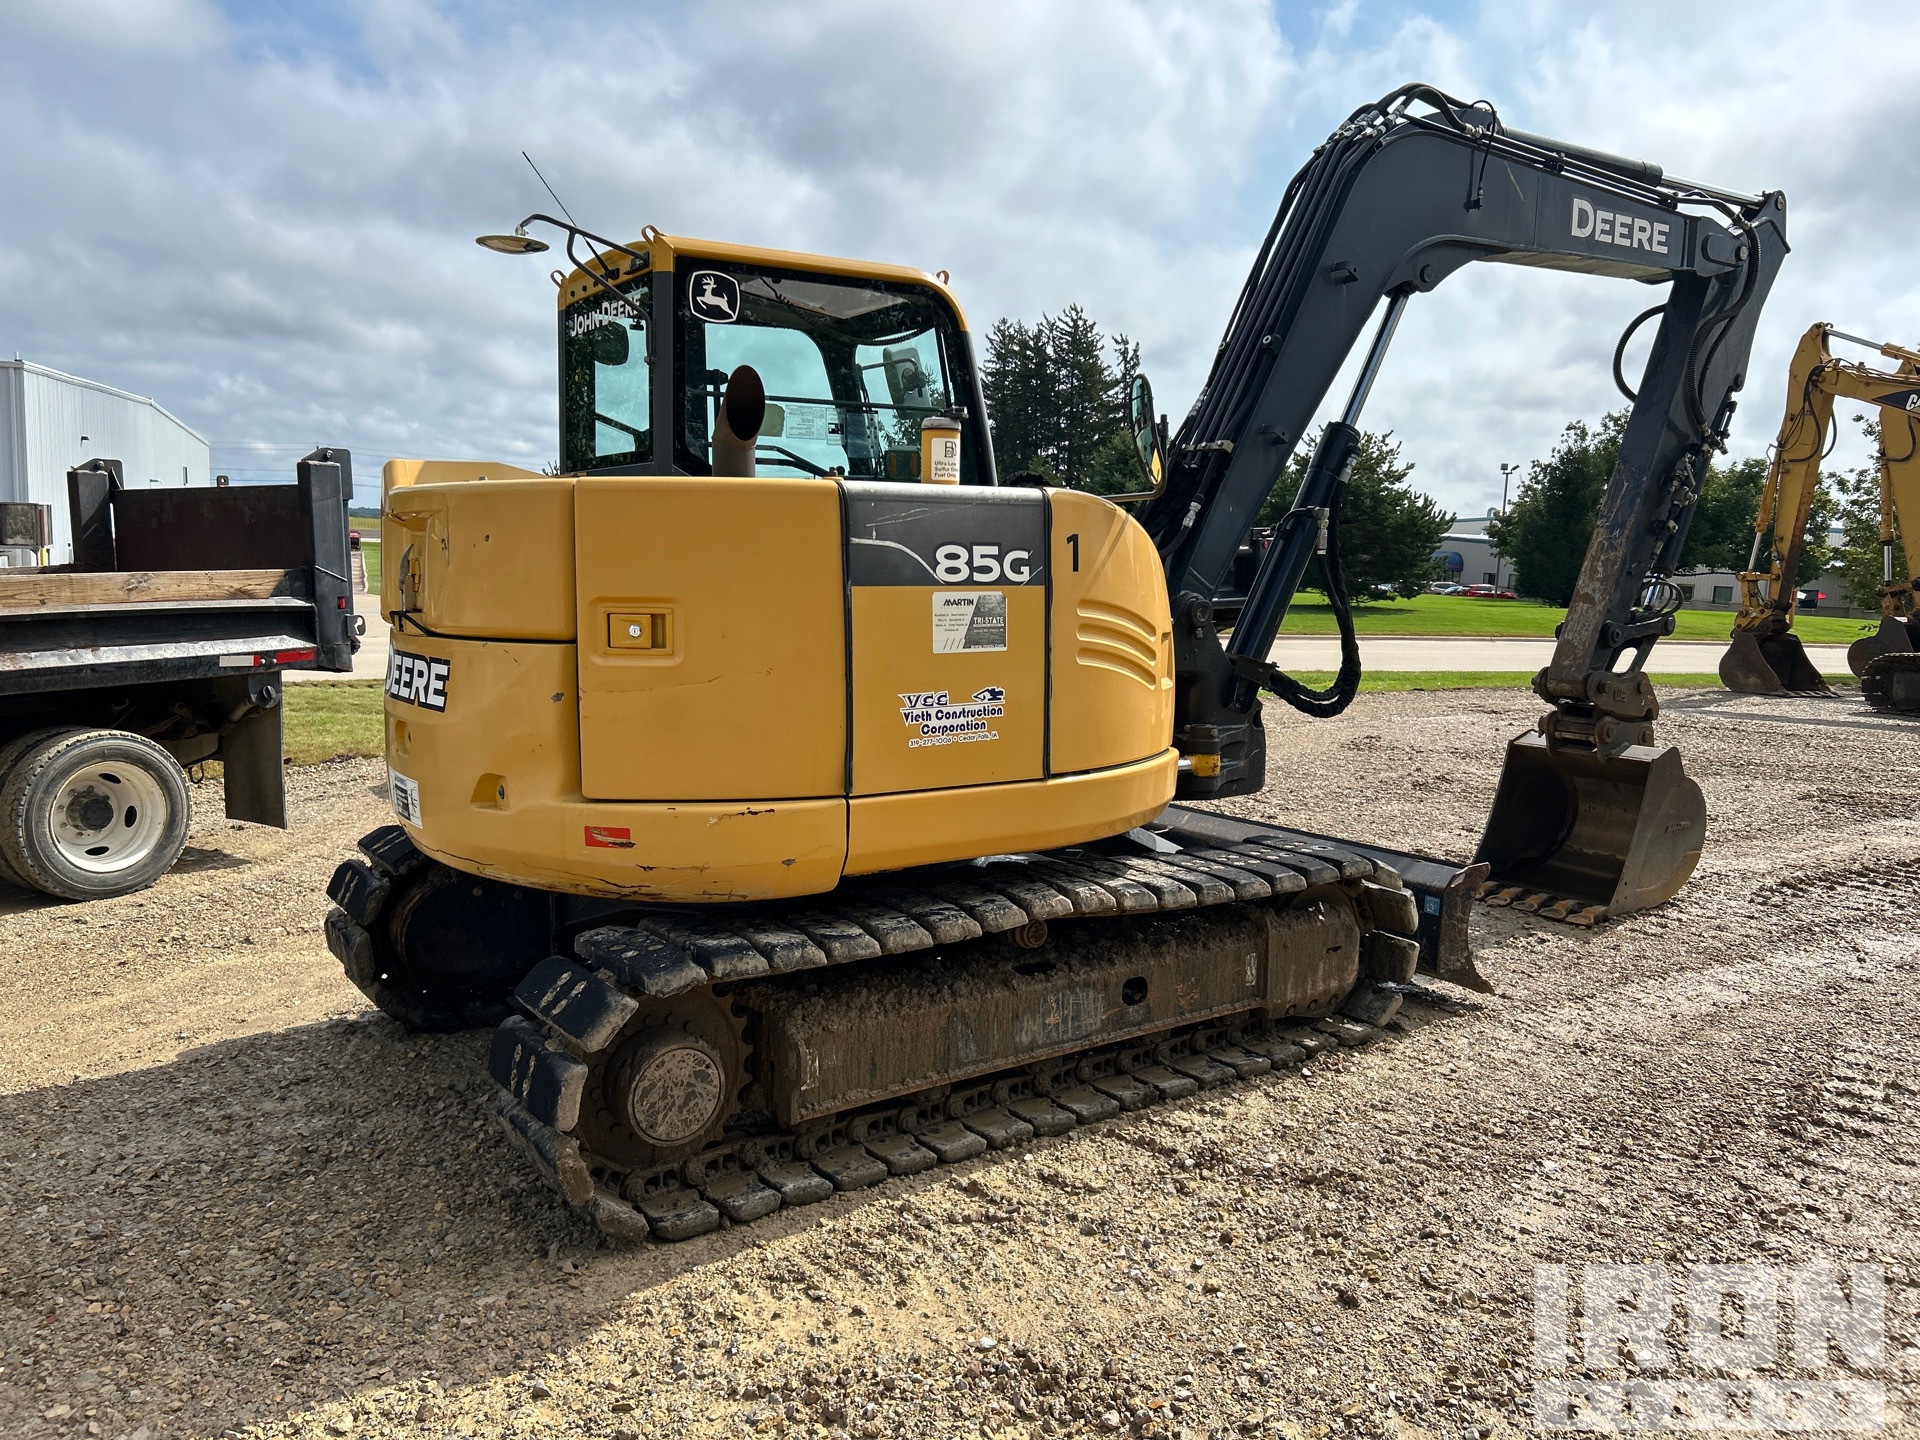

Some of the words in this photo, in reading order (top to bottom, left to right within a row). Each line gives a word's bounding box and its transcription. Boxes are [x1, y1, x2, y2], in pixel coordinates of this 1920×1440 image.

[1570, 197, 1670, 254] DEERE
[571, 308, 600, 337] JOHN
[1066, 533, 1079, 573] 1
[935, 544, 1030, 583] 85G
[943, 598, 974, 607] MARTIN
[973, 616, 1004, 625] TRI-STATE
[902, 692, 948, 709] VCC
[903, 709, 932, 723] Vieth
[935, 705, 1003, 721] Construction
[921, 719, 986, 736] Corporation
[909, 737, 952, 747] 319-277-1006
[958, 734, 976, 742] Cedar
